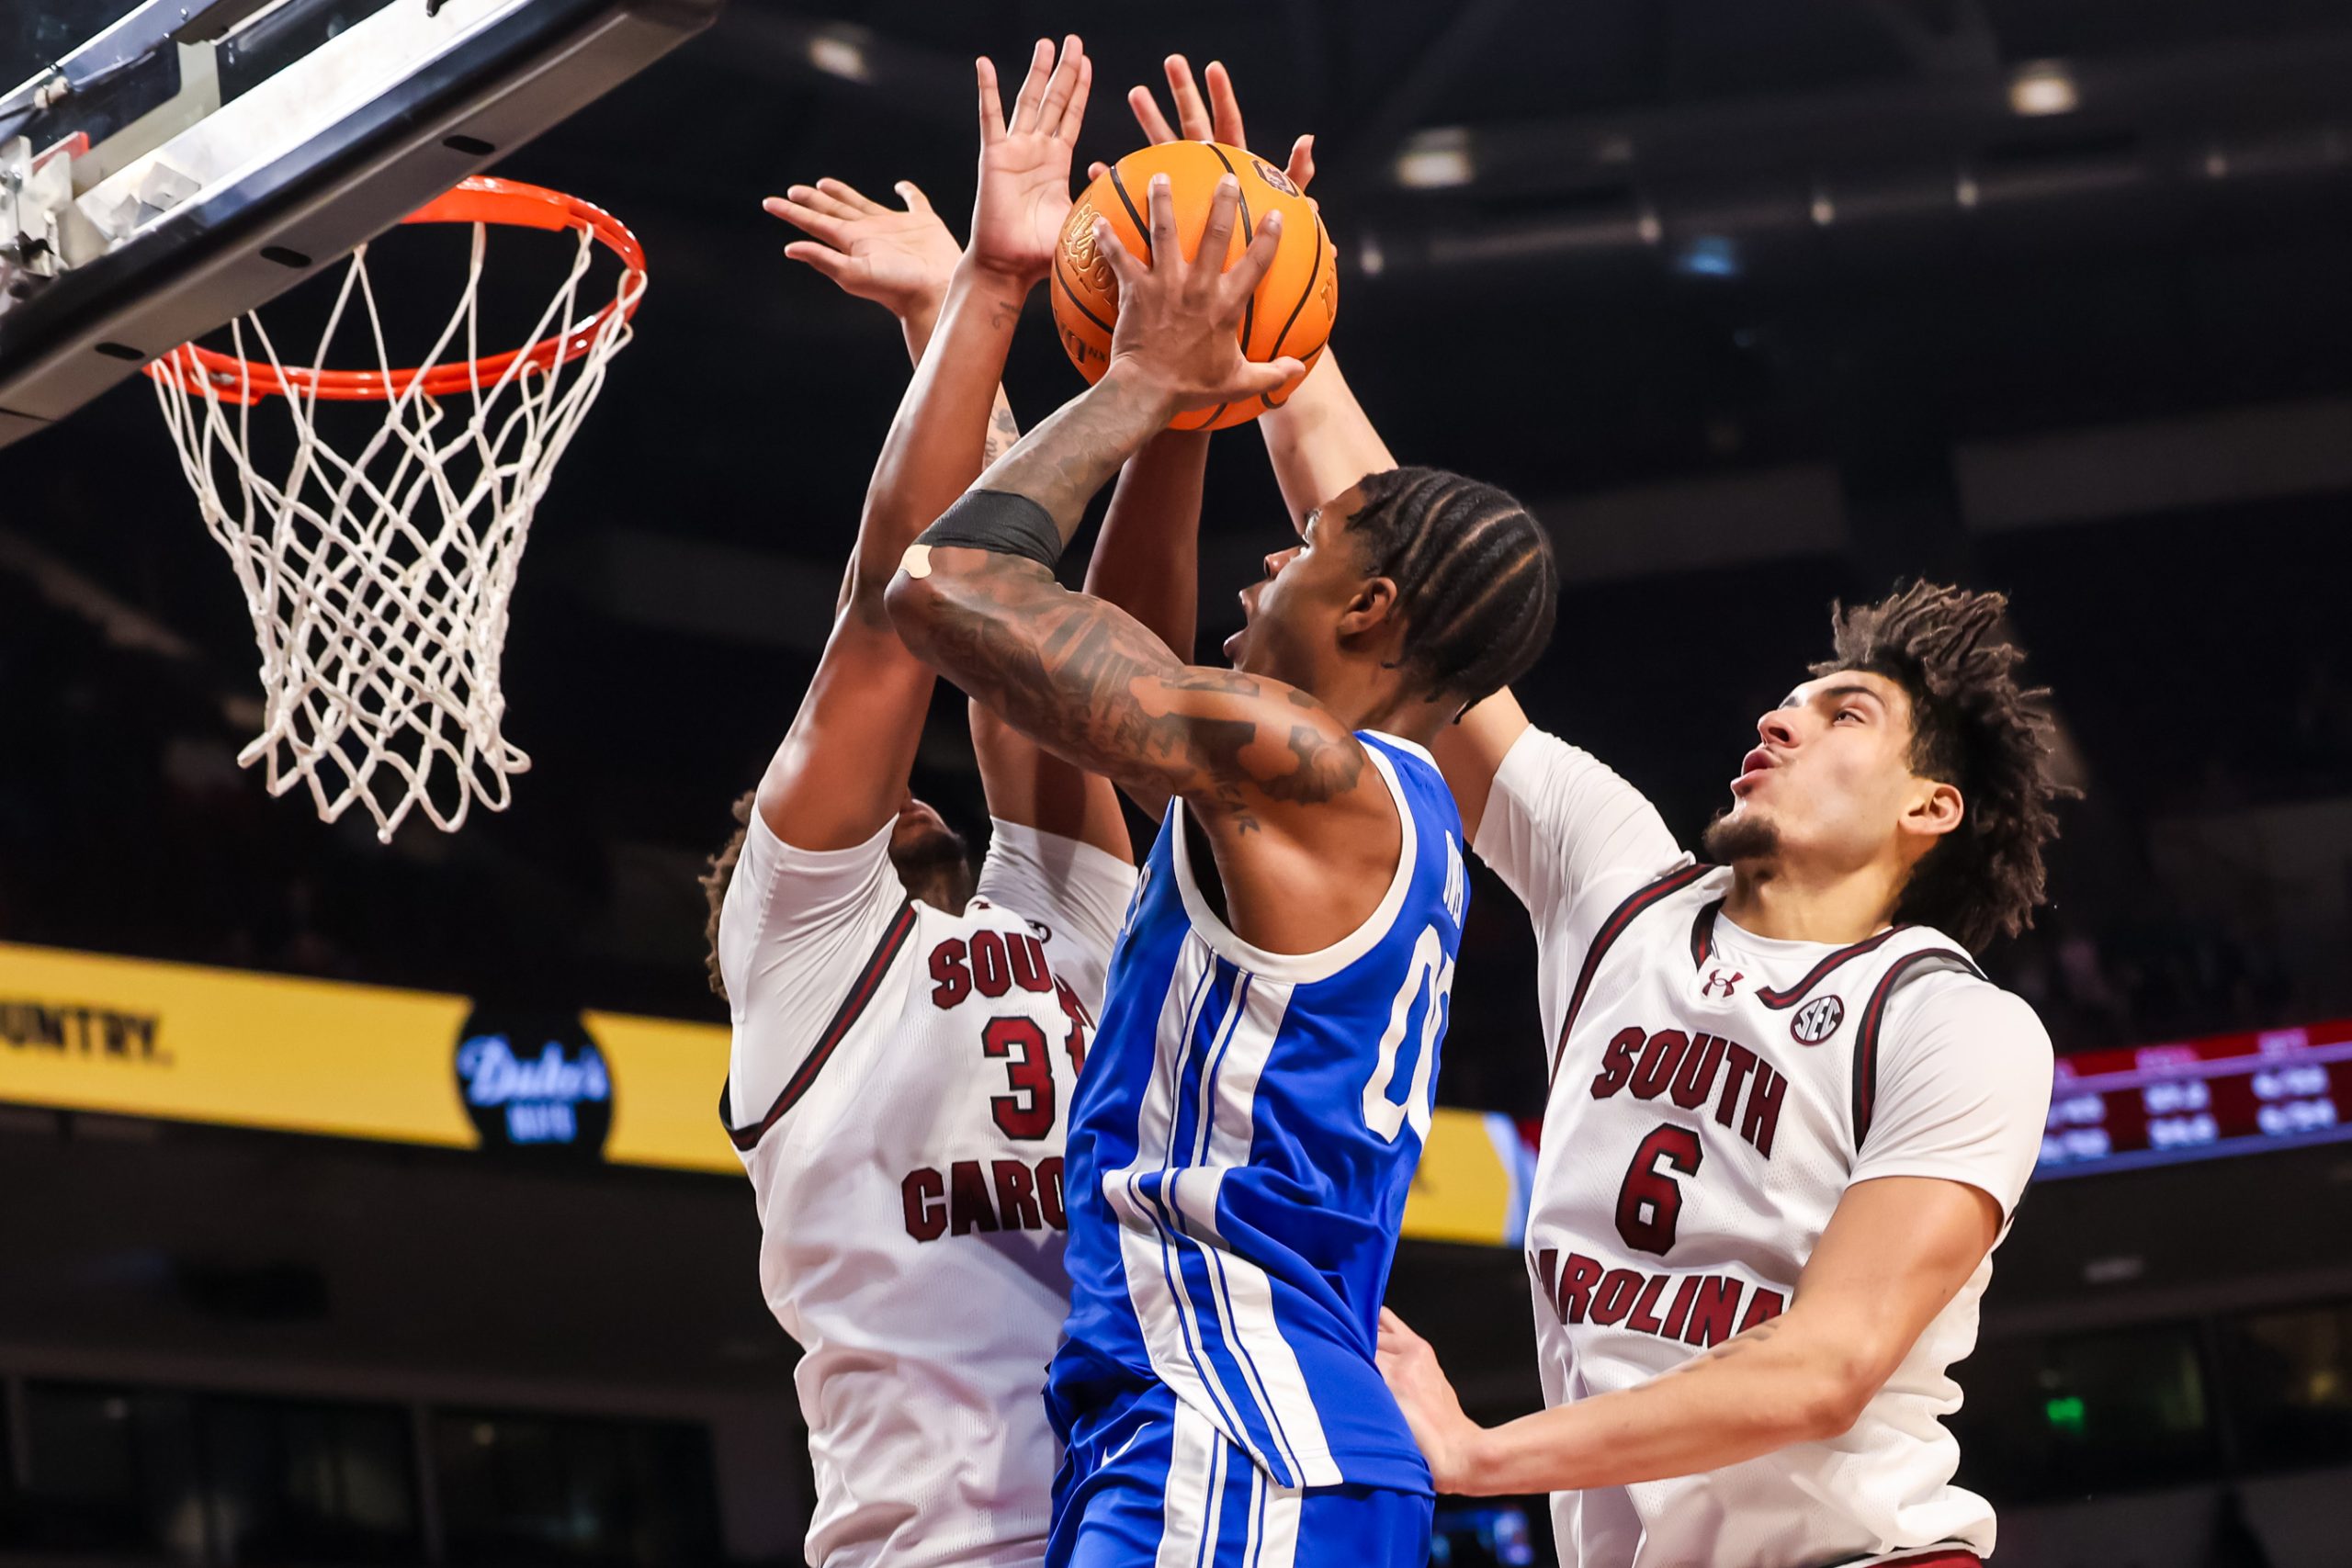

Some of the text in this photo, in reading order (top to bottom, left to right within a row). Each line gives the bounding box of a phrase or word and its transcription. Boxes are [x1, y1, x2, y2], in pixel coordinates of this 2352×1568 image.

[1793, 997, 1840, 1042] SEC
[1590, 1026, 1788, 1160] SOUTH
[1614, 1122, 1703, 1257] 6
